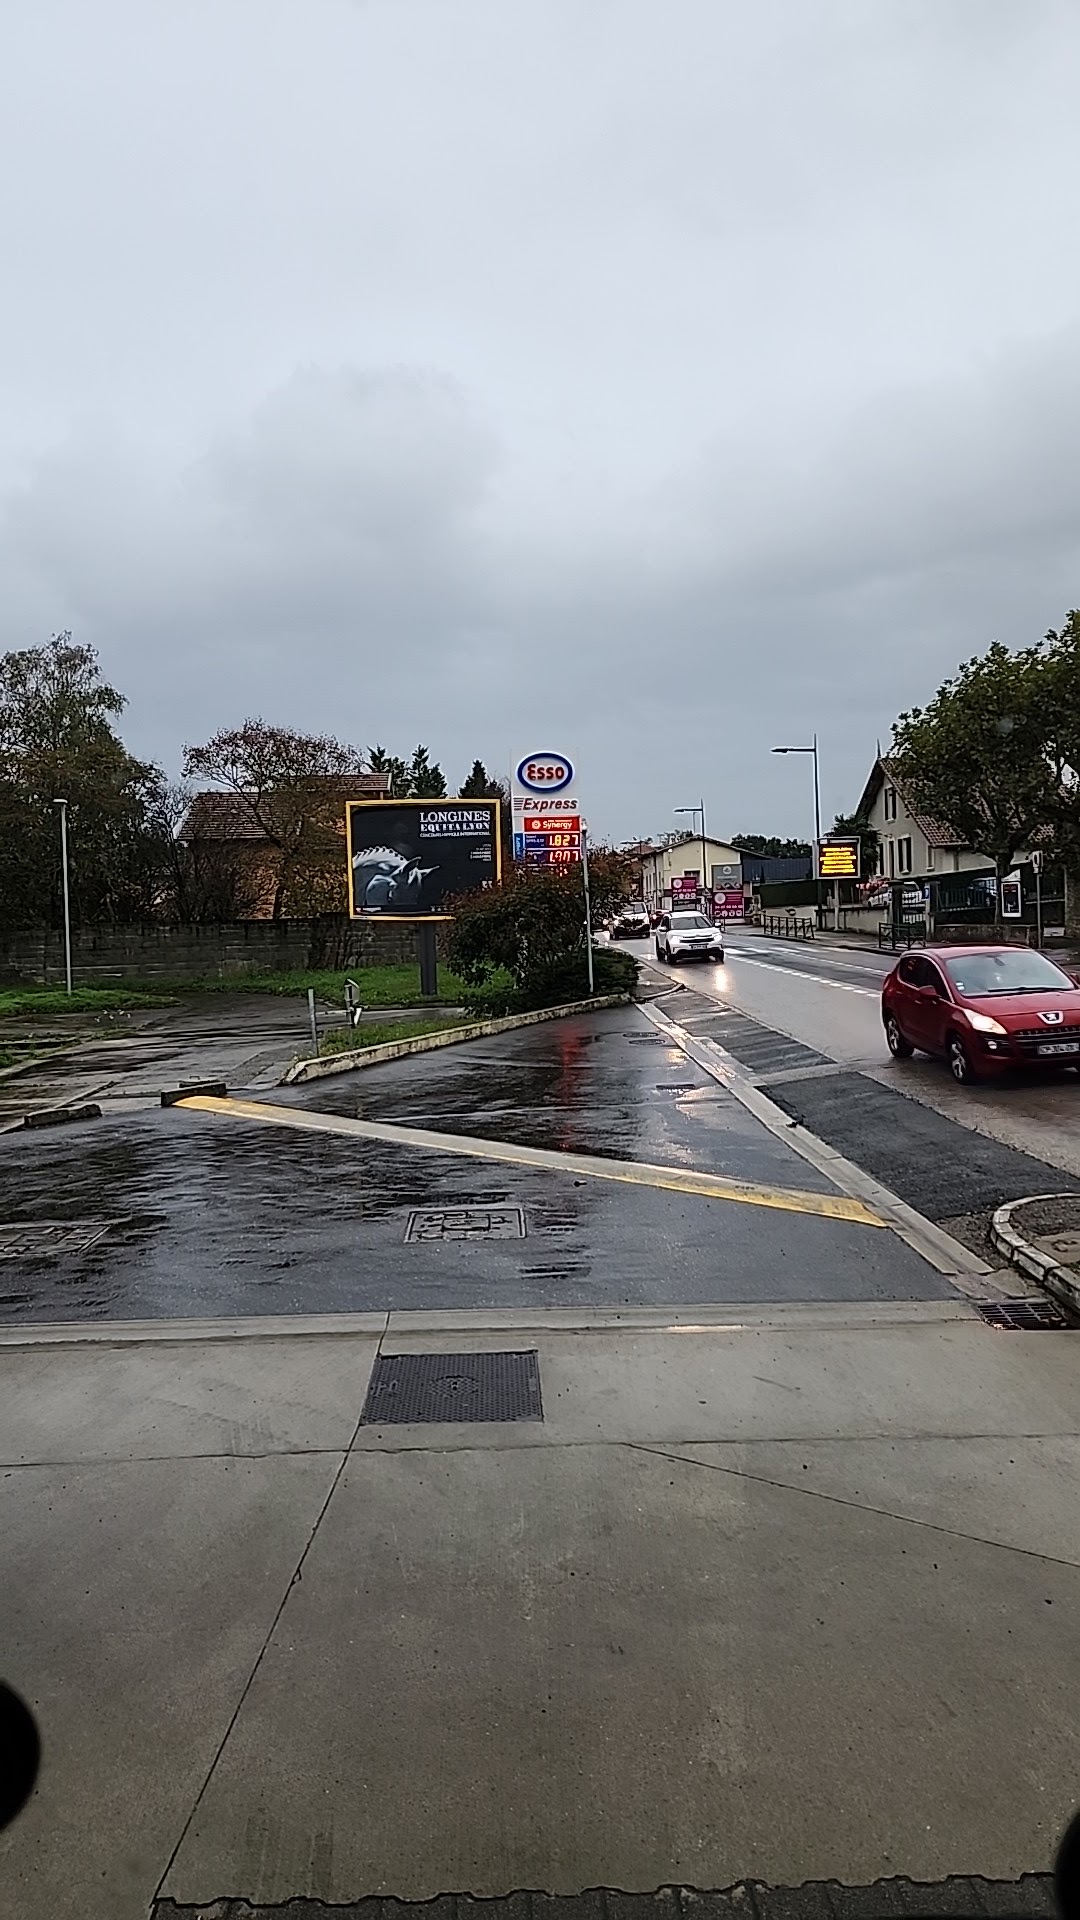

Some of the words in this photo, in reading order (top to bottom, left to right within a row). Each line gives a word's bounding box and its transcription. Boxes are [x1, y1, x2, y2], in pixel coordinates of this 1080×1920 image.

[527, 763, 565, 780] Esso
[523, 797, 578, 813] Express
[419, 810, 491, 823] LONGINES
[420, 822, 461, 833] EQUITA
[462, 822, 491, 831] LYON
[542, 820, 573, 830] Synergy
